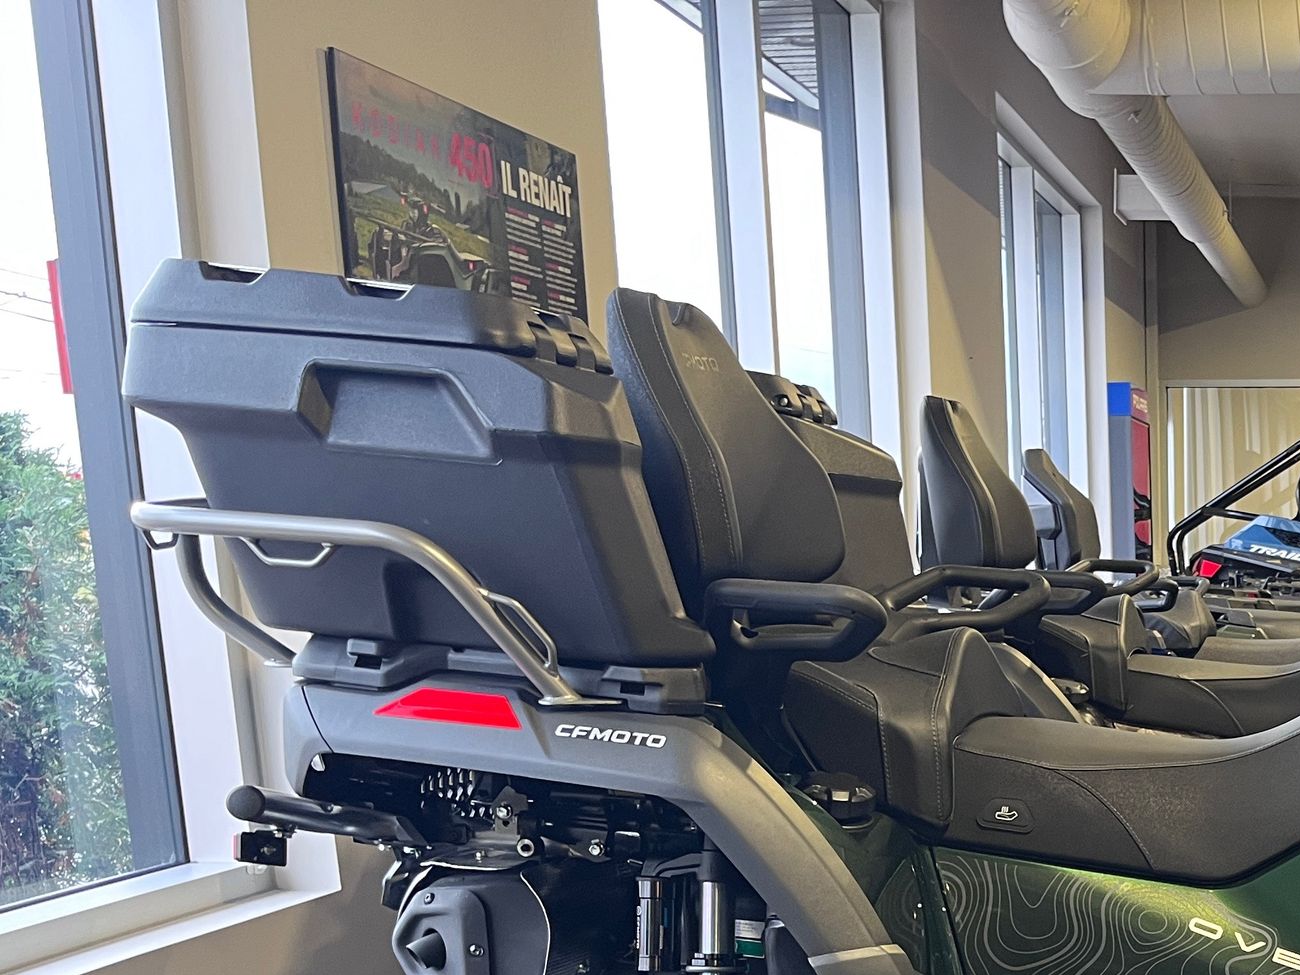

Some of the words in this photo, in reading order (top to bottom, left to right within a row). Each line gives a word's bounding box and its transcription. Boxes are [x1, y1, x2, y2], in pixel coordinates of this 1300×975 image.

[449, 132, 493, 189] 450
[501, 160, 517, 199] IL
[519, 166, 572, 218] RENAÎT
[554, 723, 667, 749] CFMOTO
